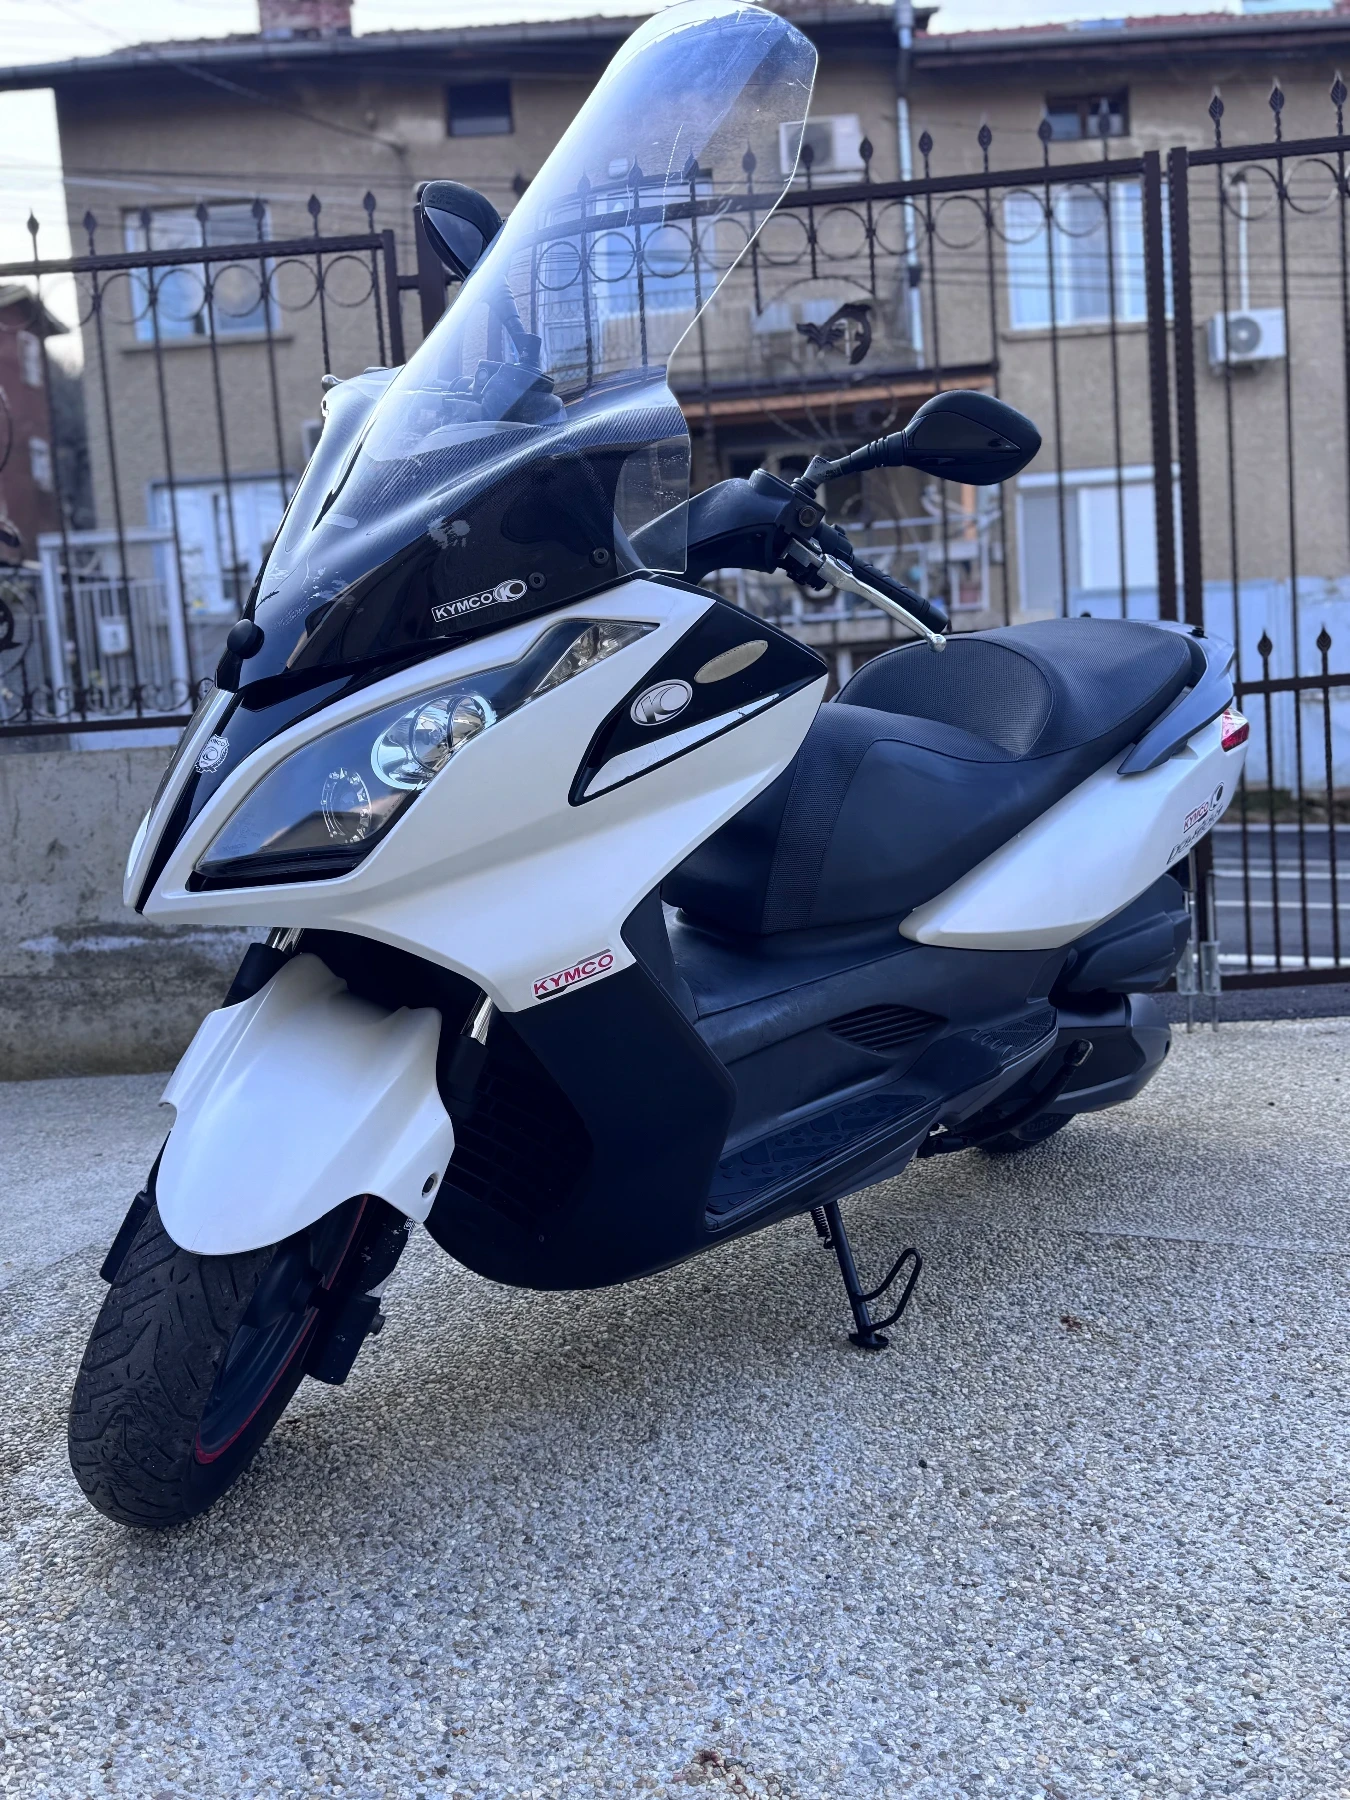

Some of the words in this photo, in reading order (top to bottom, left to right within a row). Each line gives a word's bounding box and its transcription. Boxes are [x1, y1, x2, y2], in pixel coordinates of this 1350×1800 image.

[435, 593, 493, 619] KYMCO
[1183, 801, 1209, 831] KYMCO
[533, 954, 614, 995] KYMCO
